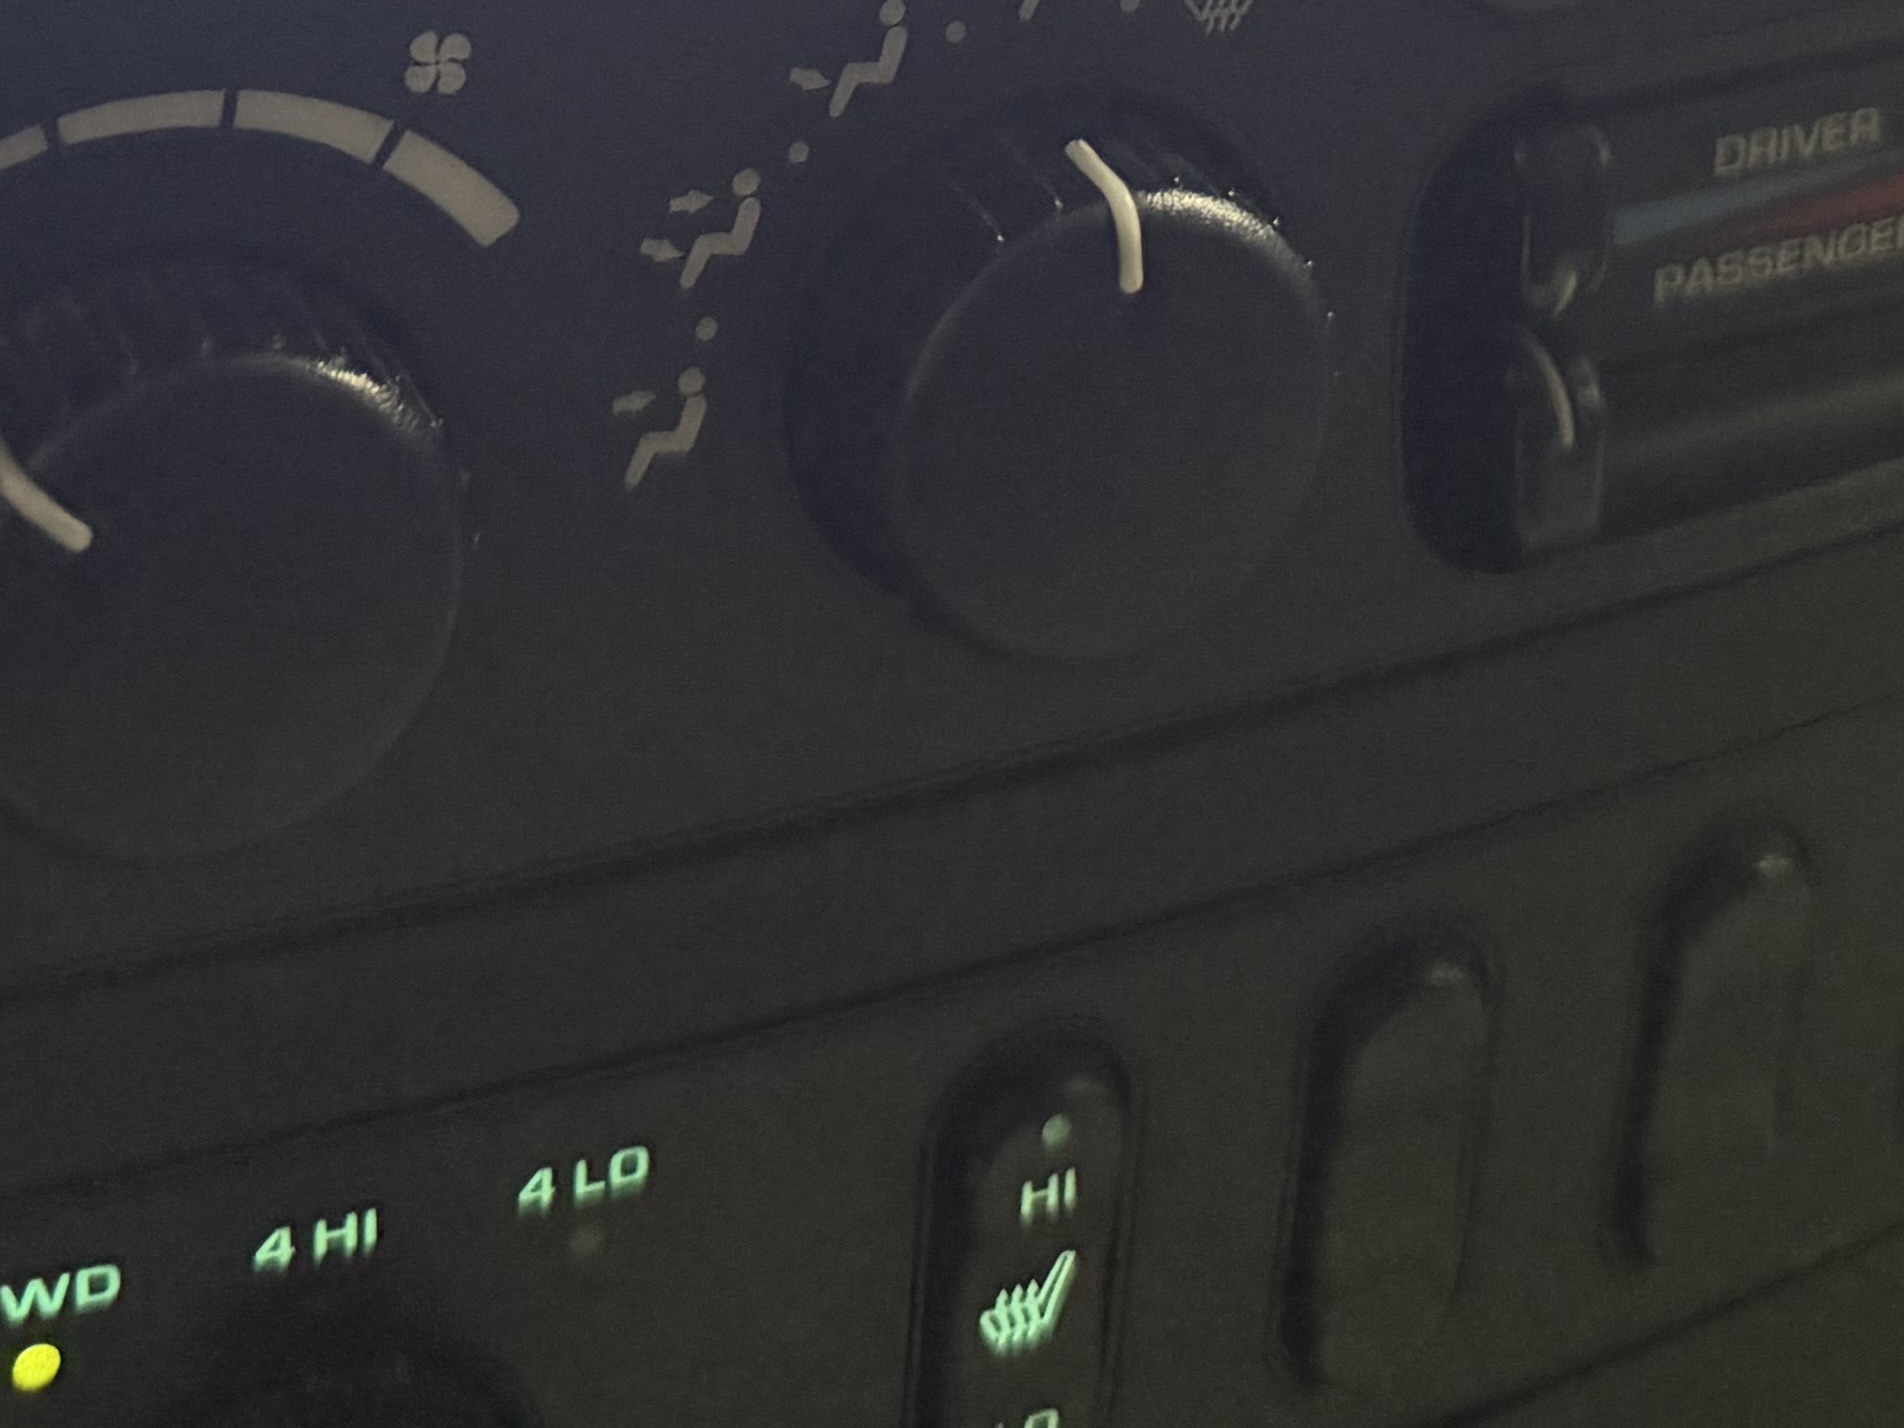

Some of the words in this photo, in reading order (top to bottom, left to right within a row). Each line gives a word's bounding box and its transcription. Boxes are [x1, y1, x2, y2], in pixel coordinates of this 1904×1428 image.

[1713, 106, 1881, 177] DRIVER
[517, 1166, 556, 1212] 4
[574, 1146, 650, 1200] LO
[1019, 1167, 1077, 1223] HI
[253, 1226, 295, 1271] 4
[313, 1208, 379, 1262] HI
[0, 1264, 122, 1324] WD
